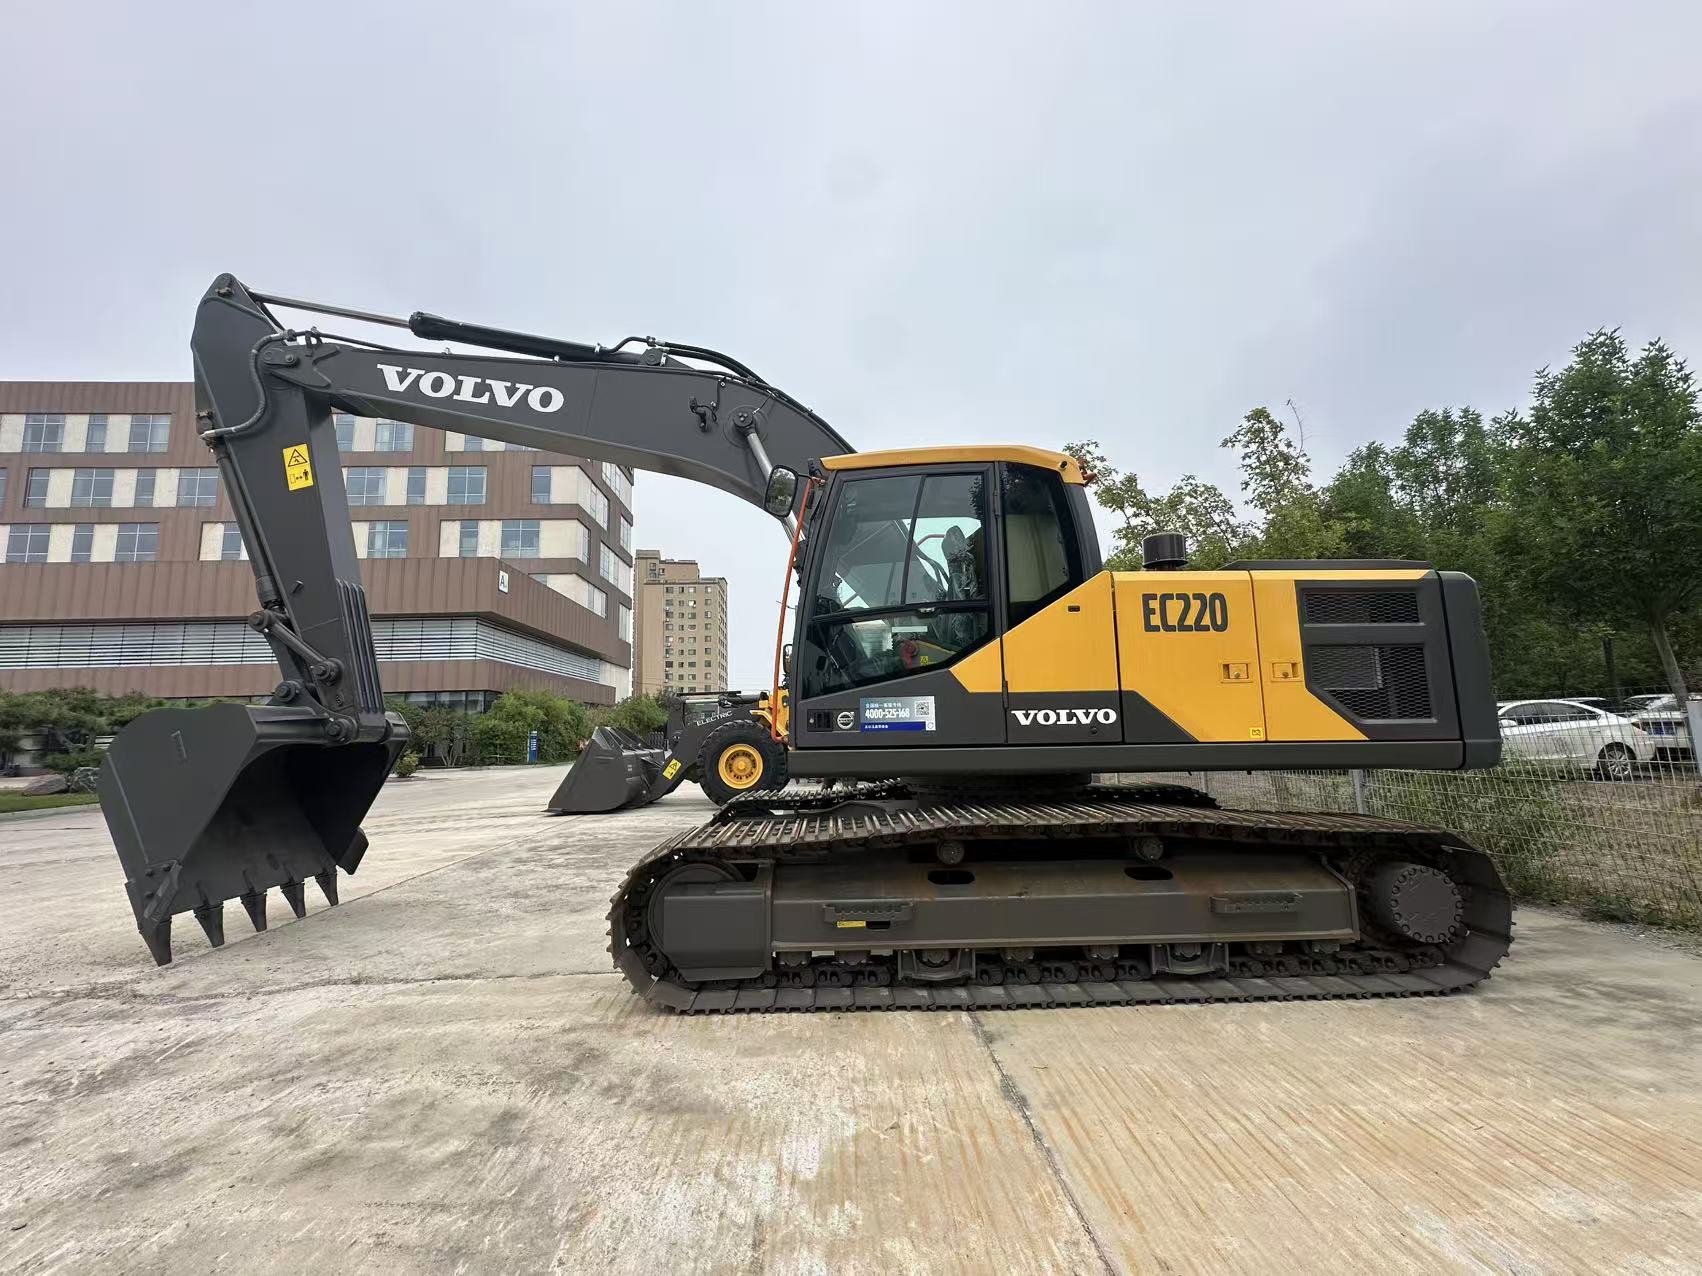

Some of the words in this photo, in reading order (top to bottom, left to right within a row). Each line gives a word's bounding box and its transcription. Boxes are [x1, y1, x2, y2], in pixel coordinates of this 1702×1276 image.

[376, 363, 565, 413] VOLVO
[1142, 592, 1229, 632] EC220
[696, 710, 733, 726] ELECTRIC
[864, 708, 910, 719] 4000-525-168
[1010, 708, 1117, 726] VOLVO
